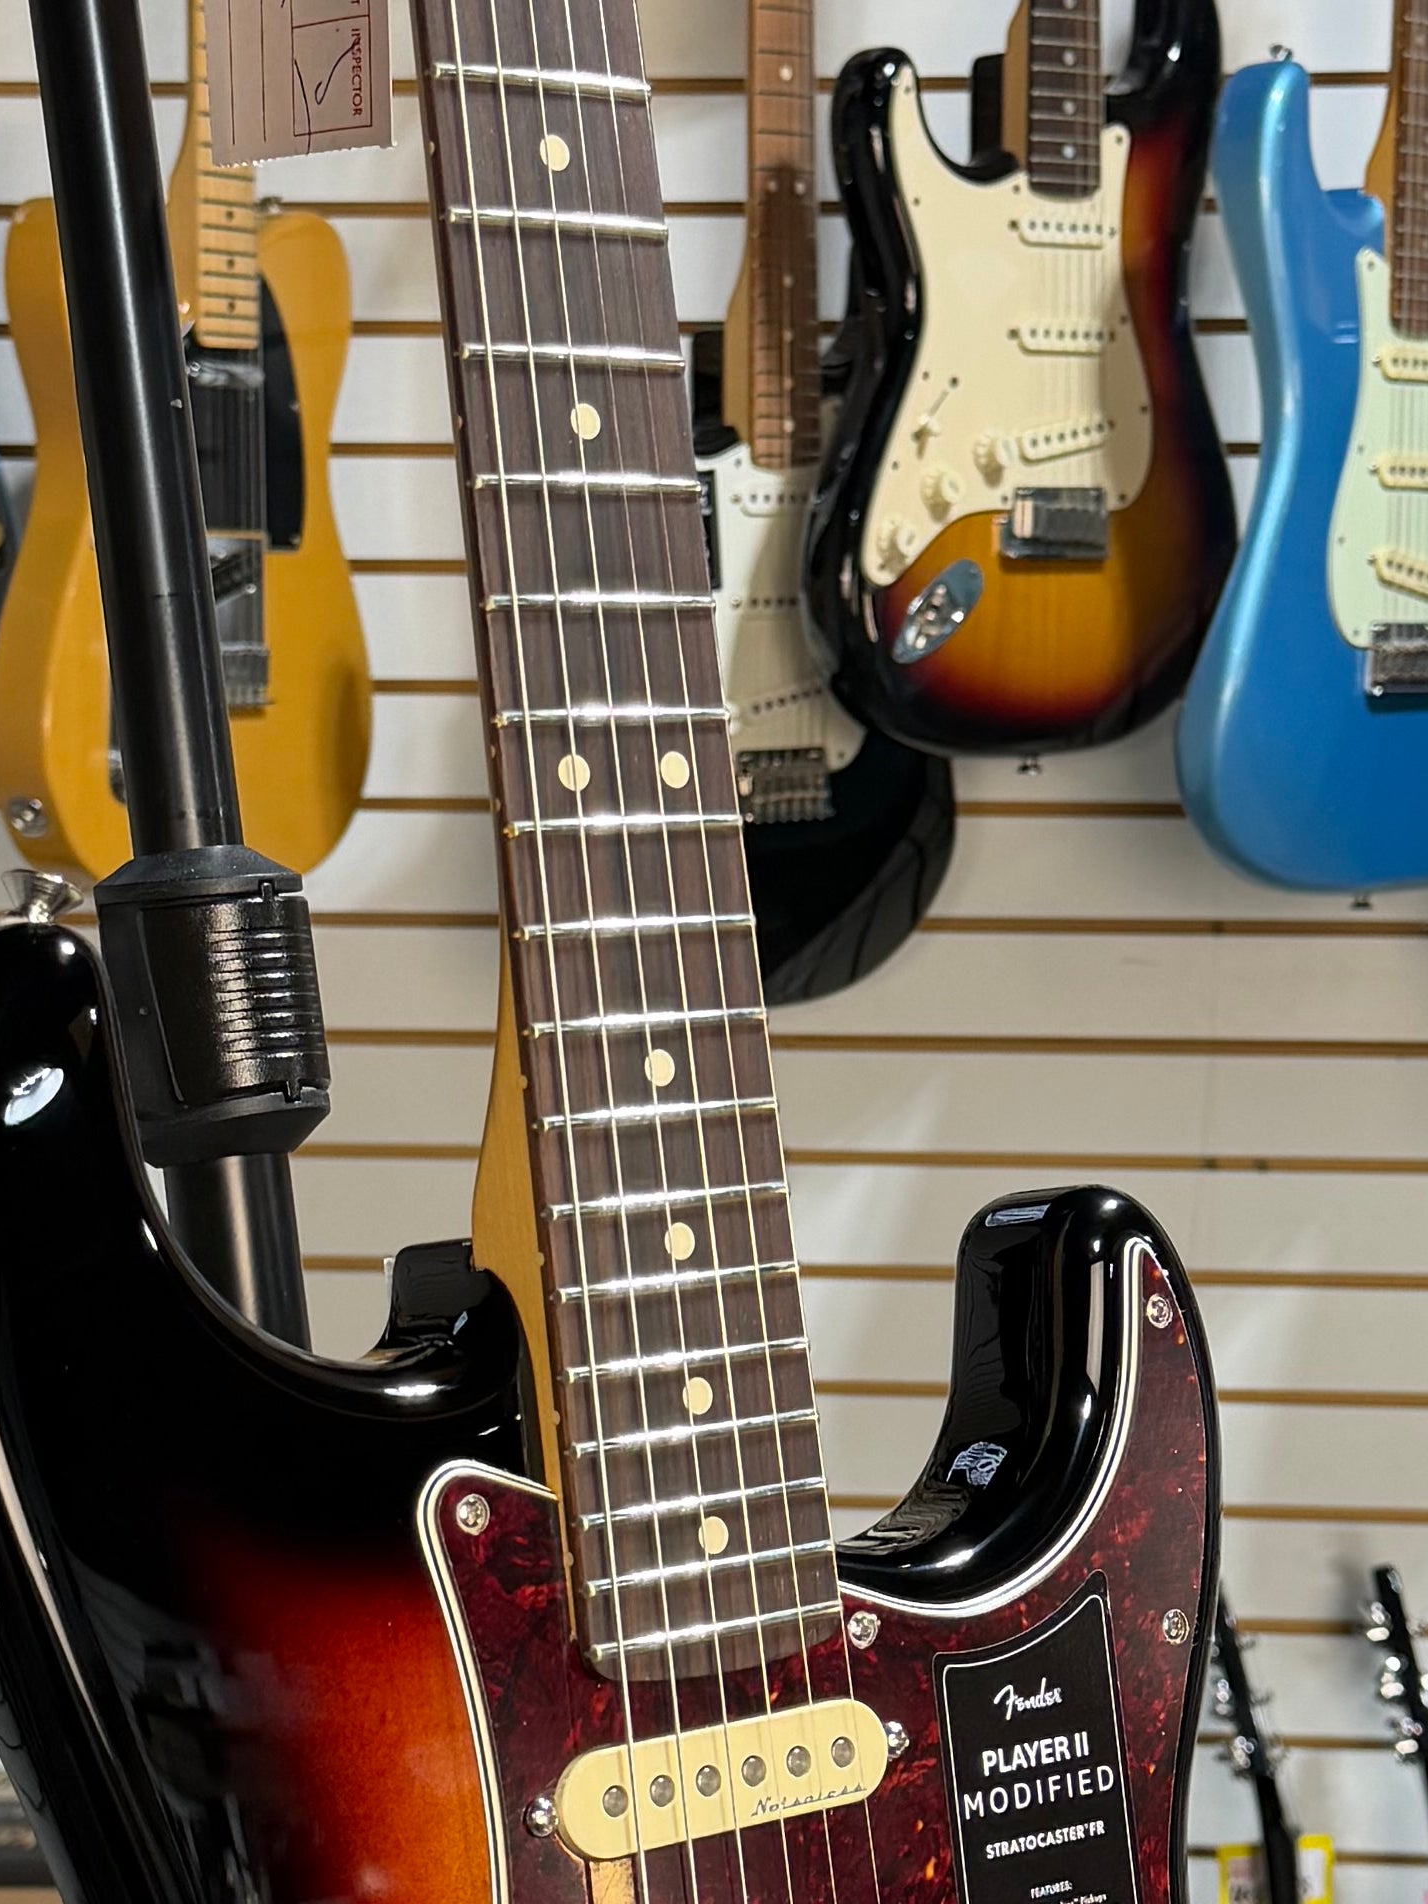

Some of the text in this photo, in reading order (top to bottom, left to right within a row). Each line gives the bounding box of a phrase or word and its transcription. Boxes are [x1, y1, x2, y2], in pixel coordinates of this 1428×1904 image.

[992, 1676, 1063, 1722] Fender
[981, 1730, 1090, 1778] PLAYER II
[962, 1764, 1115, 1821] MODIFIED
[1088, 1819, 1106, 1837] FR
[1030, 1879, 1074, 1900] FEATURES:
